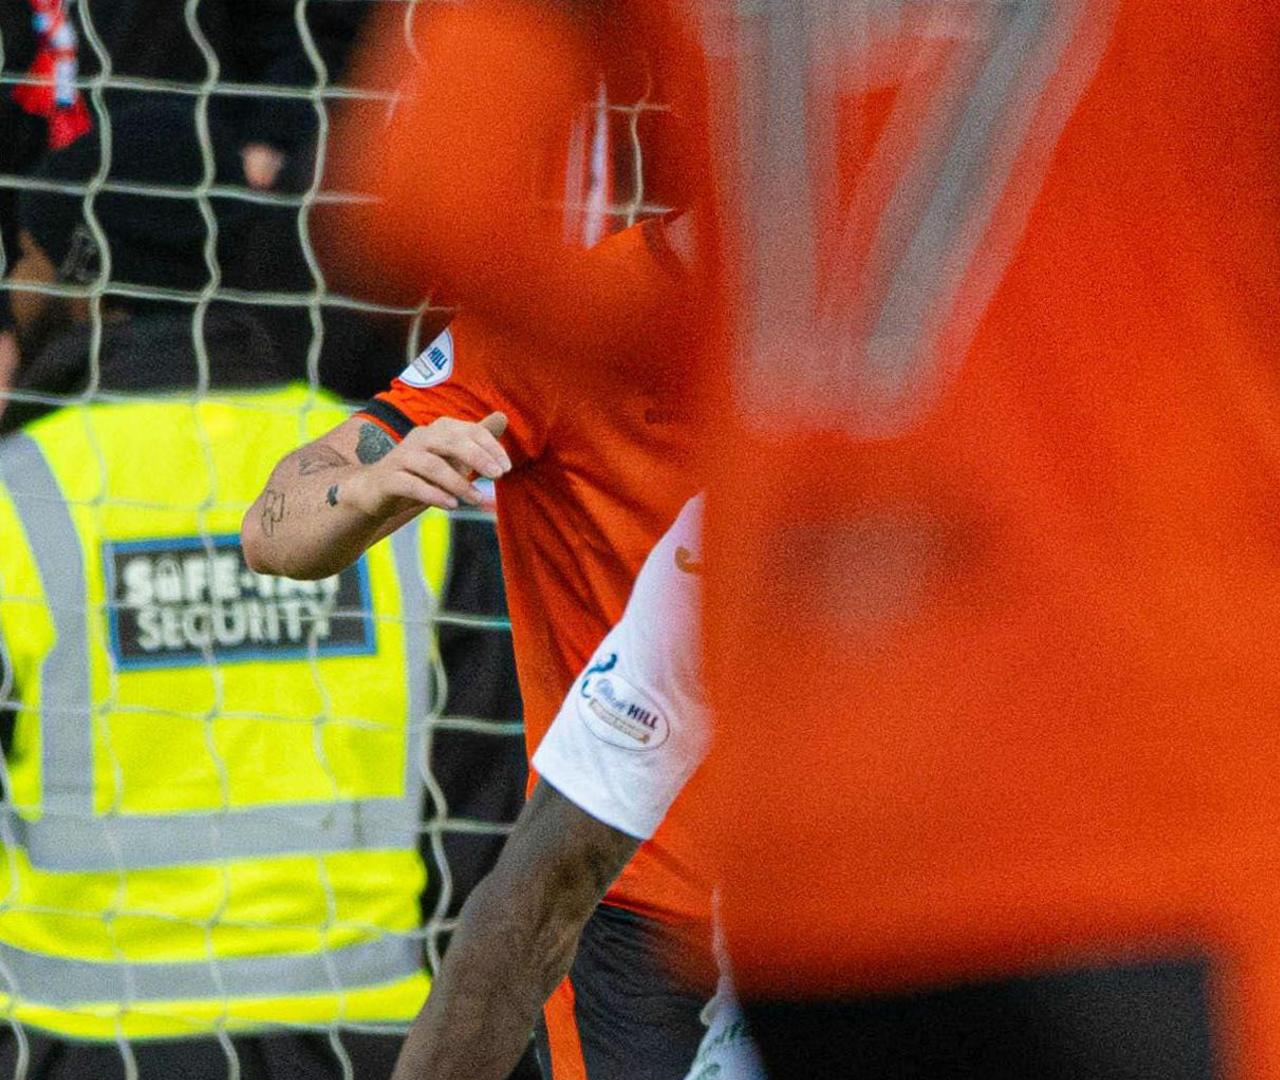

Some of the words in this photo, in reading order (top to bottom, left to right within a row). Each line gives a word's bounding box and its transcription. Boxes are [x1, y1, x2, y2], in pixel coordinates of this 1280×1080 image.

[124, 553, 340, 607] SAFE-
[137, 599, 334, 652] SECURITY
[627, 703, 658, 731] HILL
